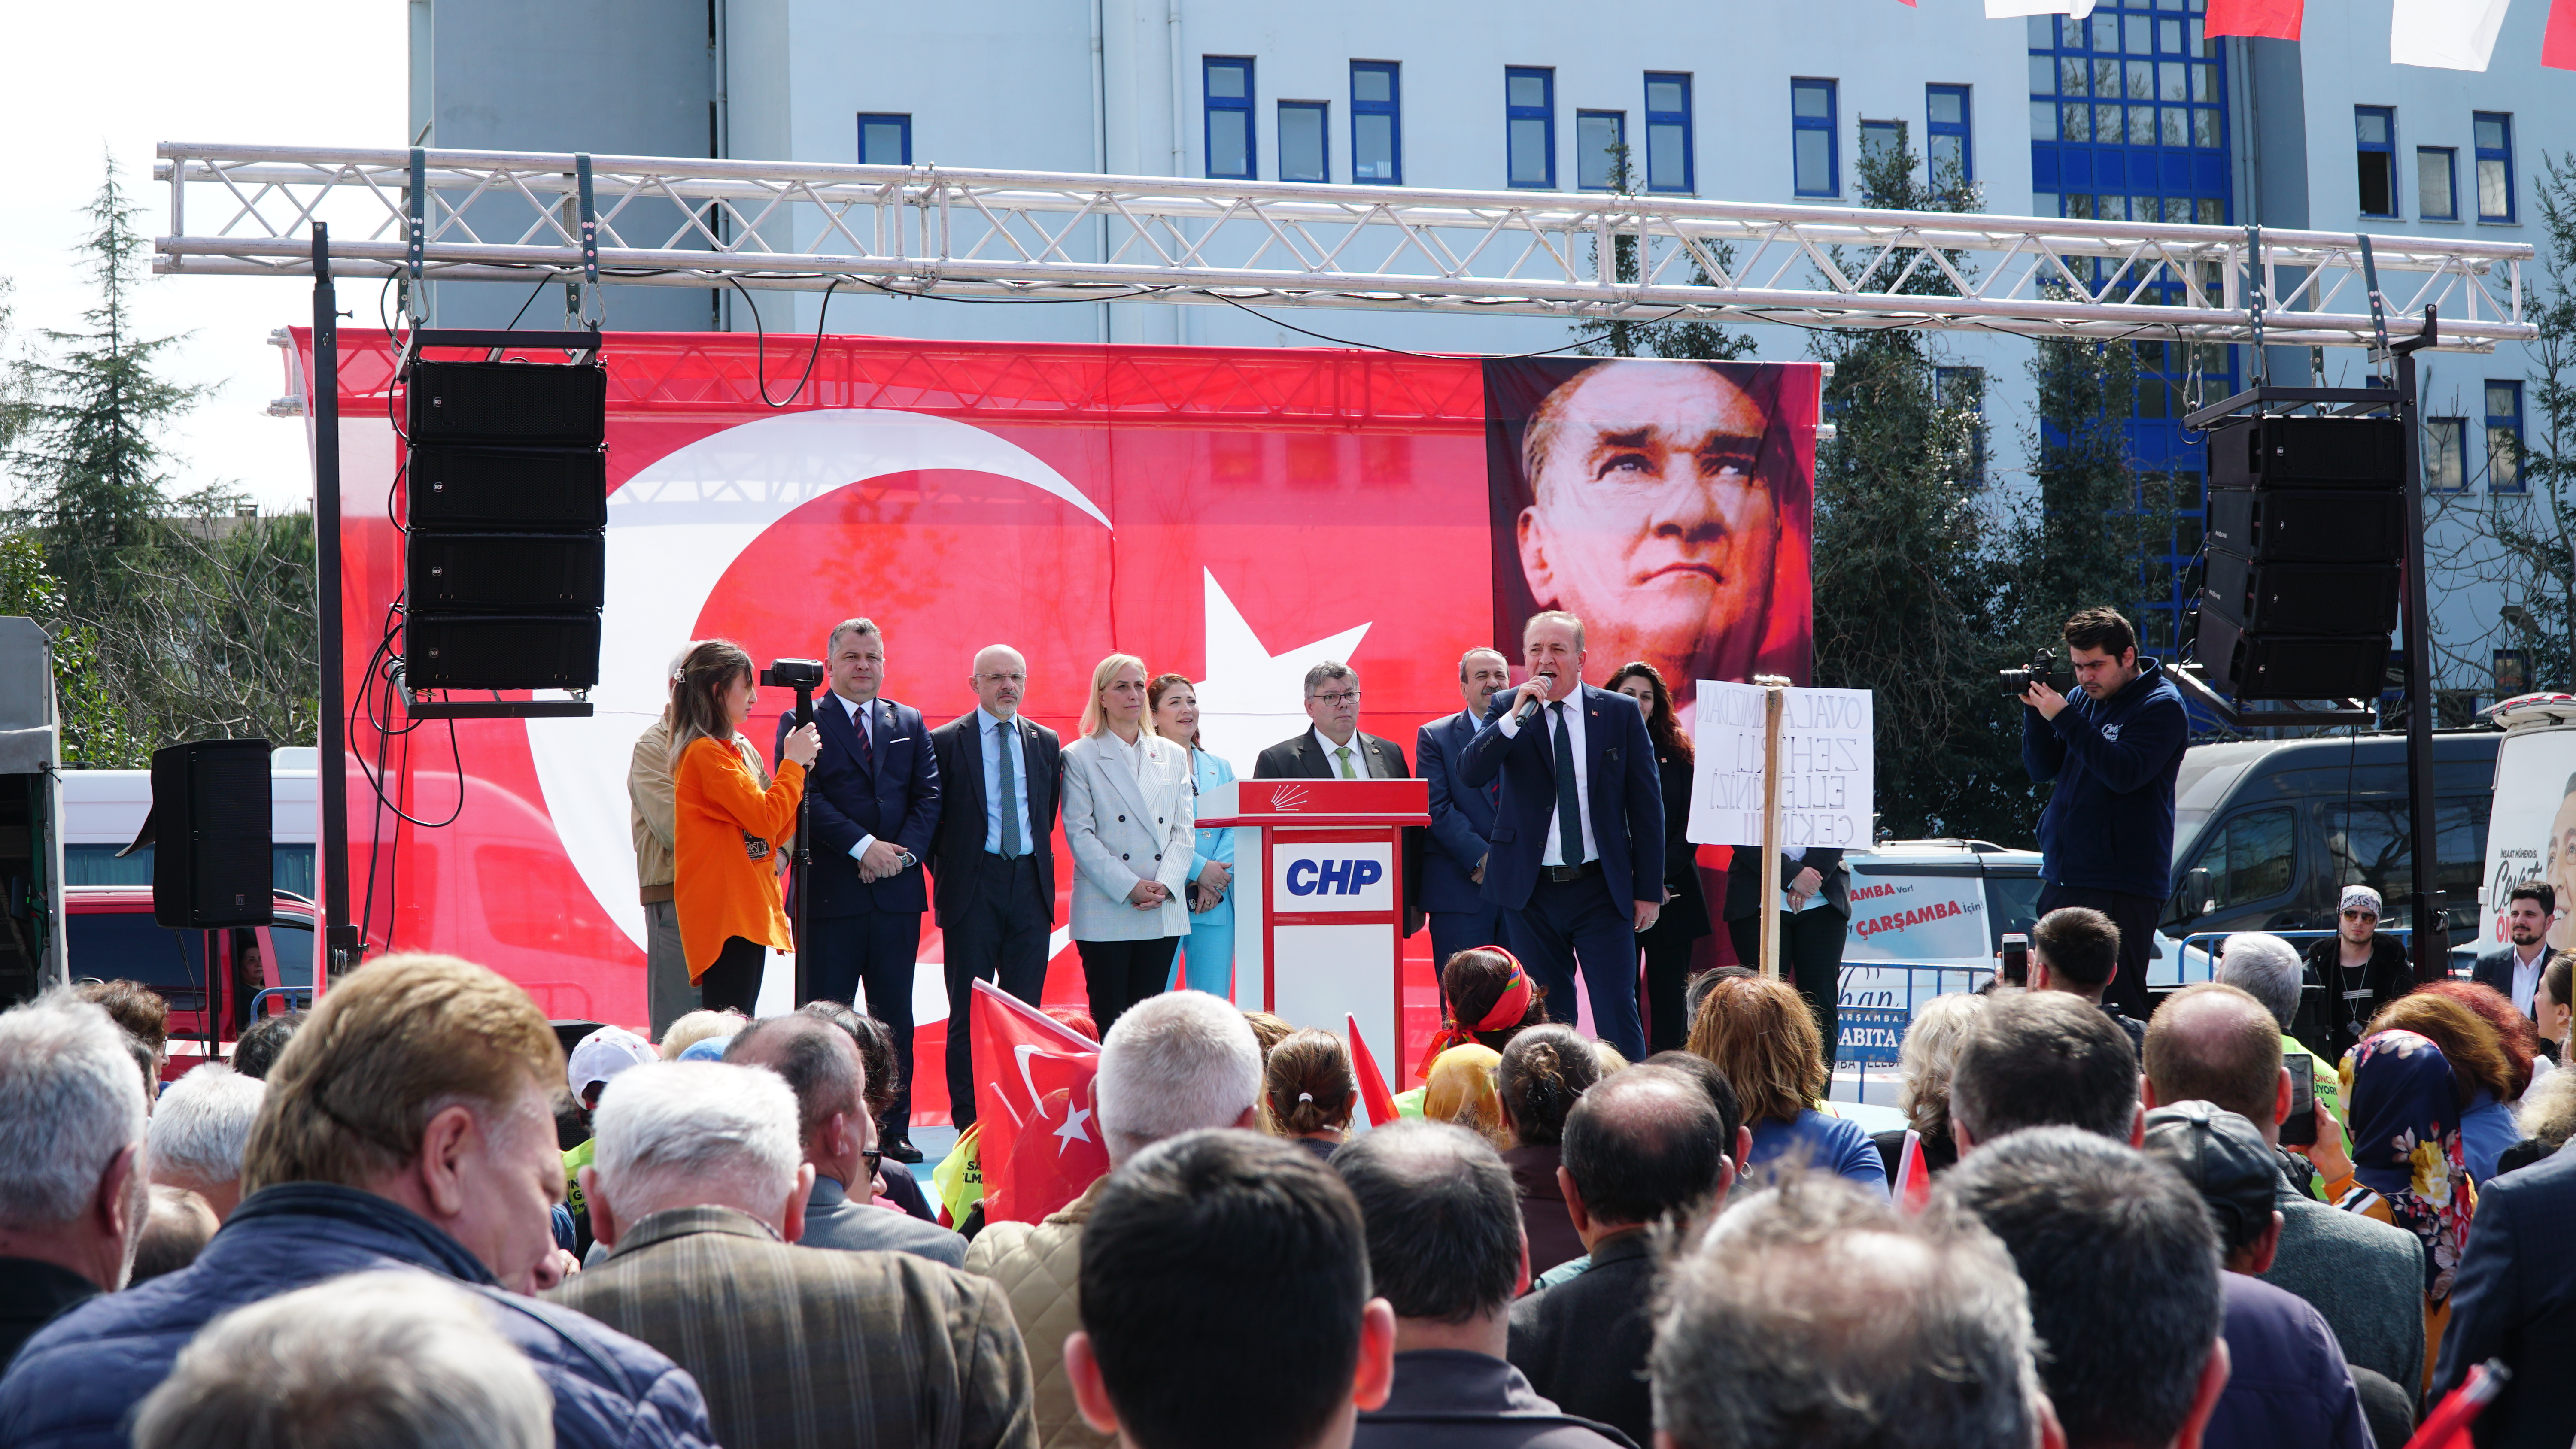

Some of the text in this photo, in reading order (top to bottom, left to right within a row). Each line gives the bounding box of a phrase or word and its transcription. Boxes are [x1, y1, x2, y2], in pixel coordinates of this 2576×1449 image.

[1286, 859, 1382, 896] CHP
[1896, 884, 1914, 894] Var!
[1856, 900, 1962, 940] ÇARŞAMBA
[1962, 900, 1985, 915] İçin!
[1838, 1028, 1899, 1048] ABITA
